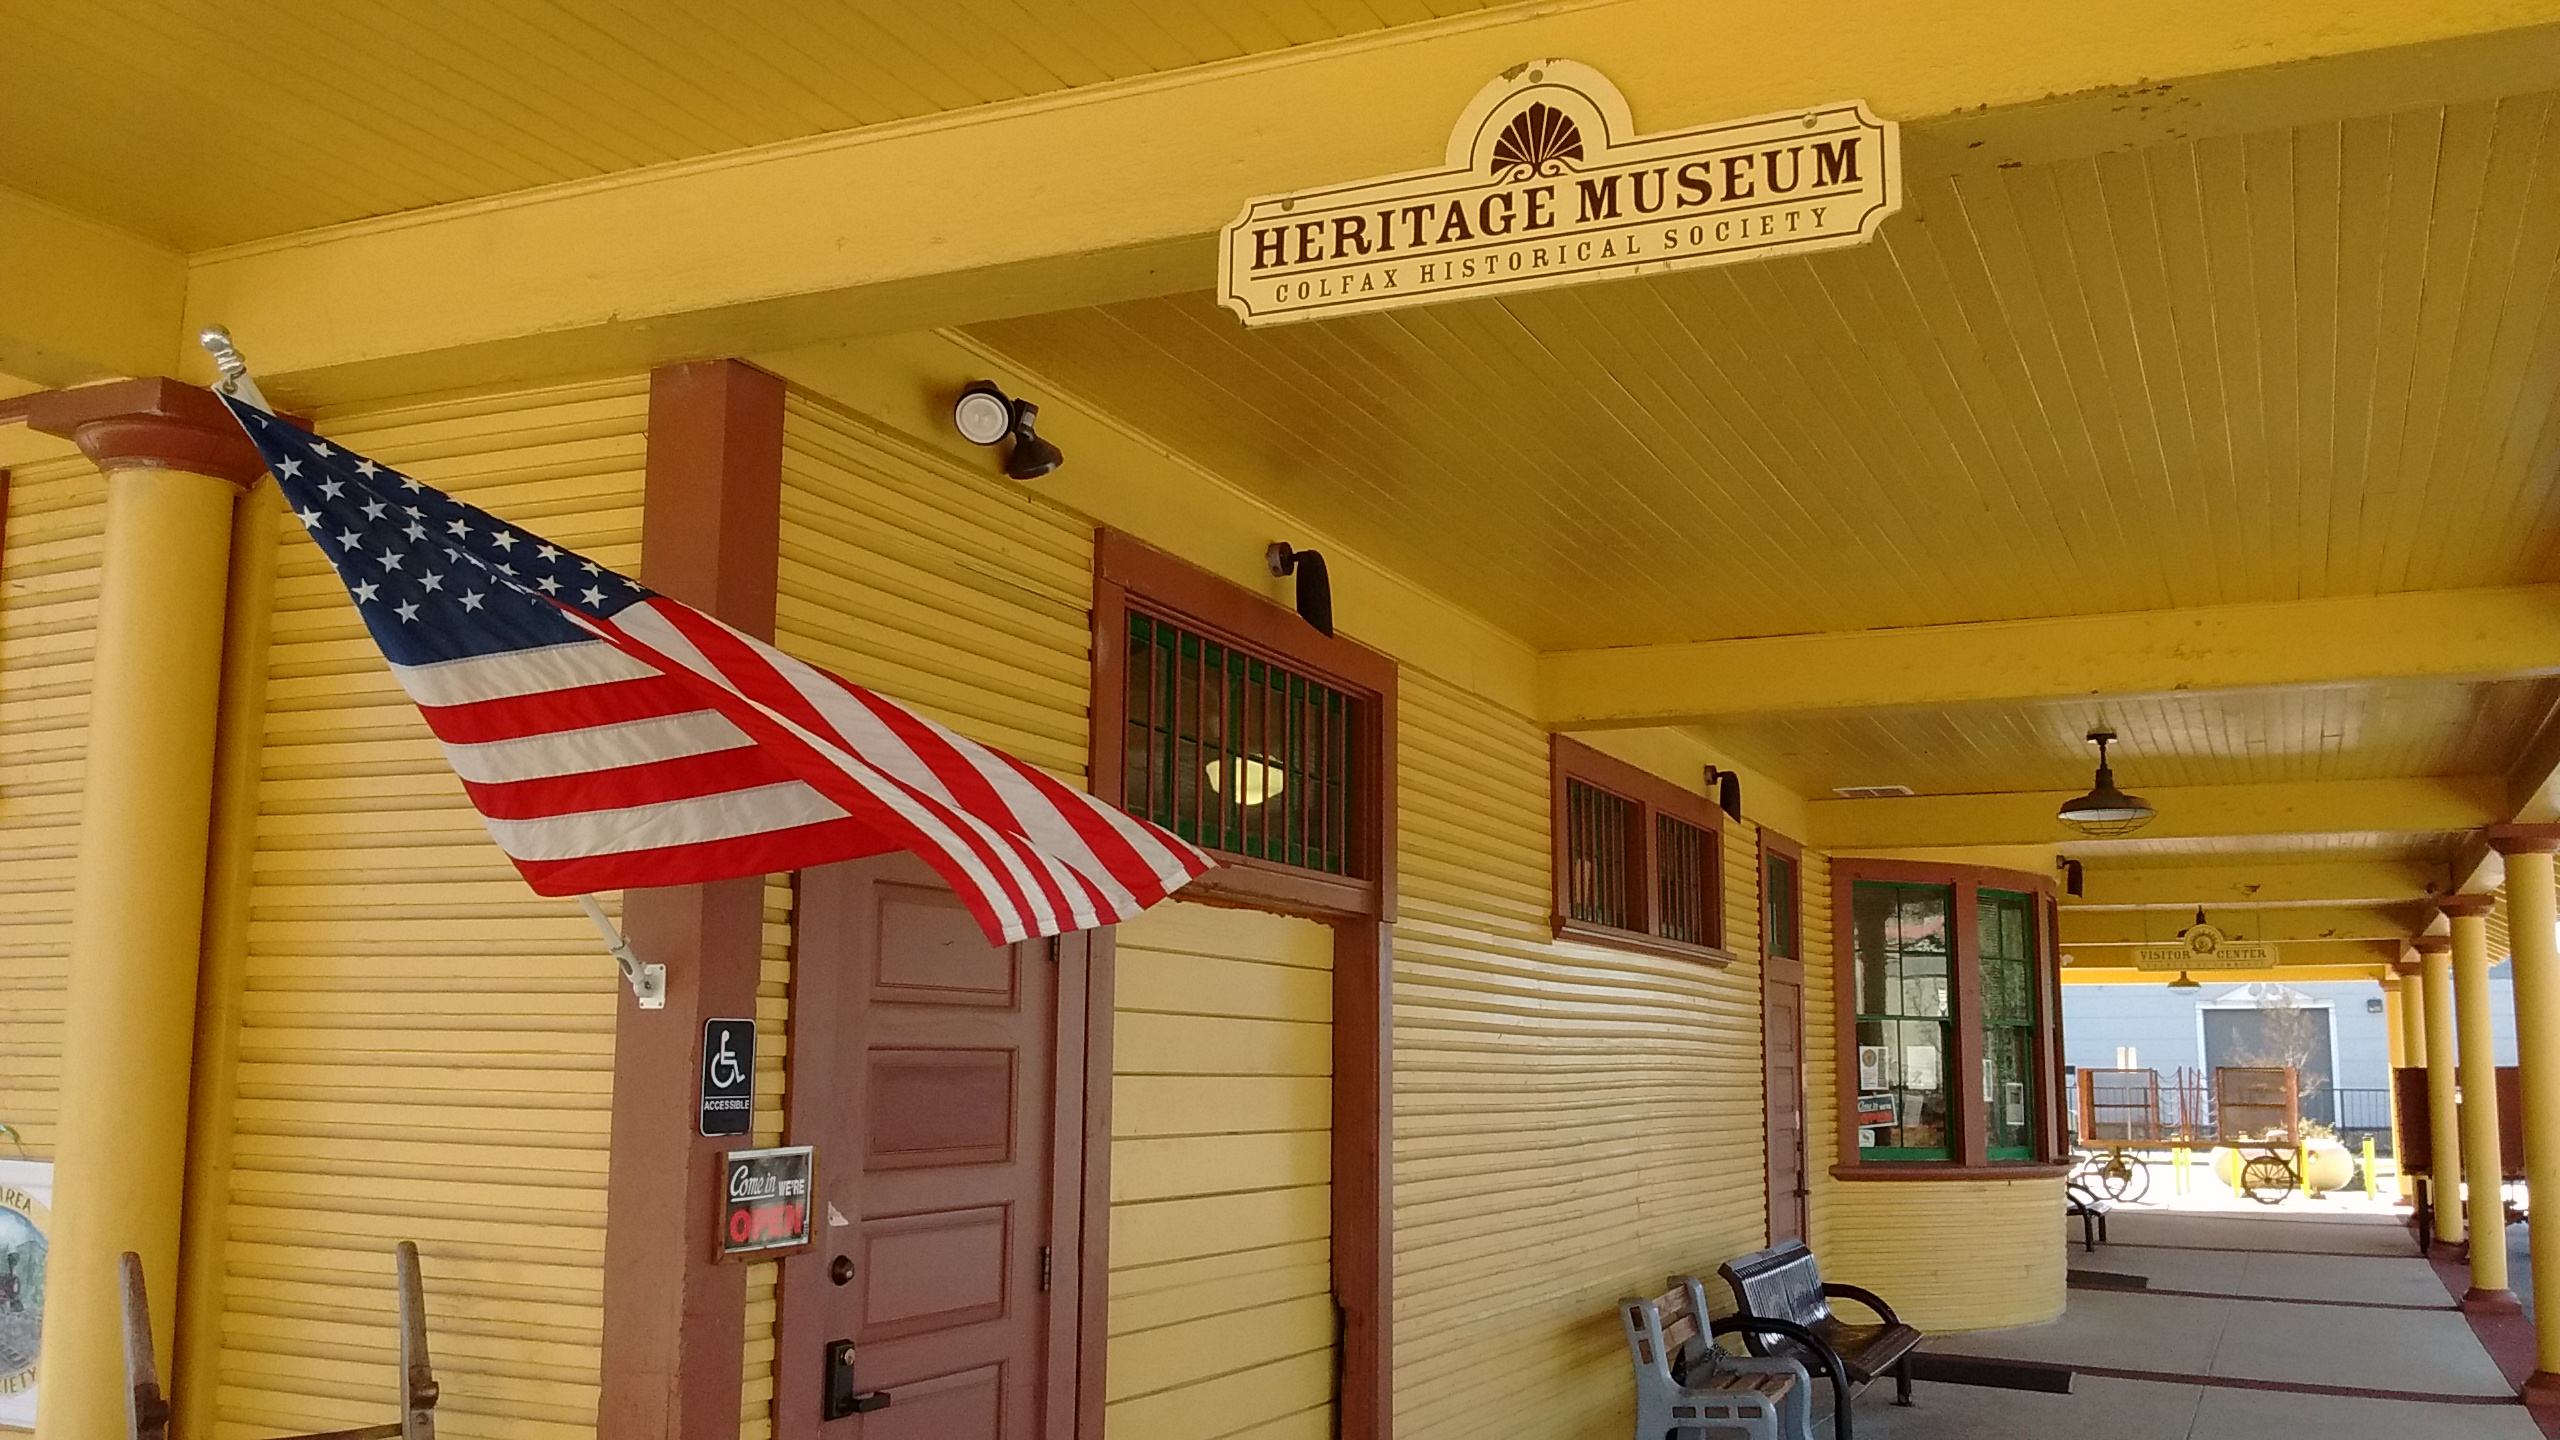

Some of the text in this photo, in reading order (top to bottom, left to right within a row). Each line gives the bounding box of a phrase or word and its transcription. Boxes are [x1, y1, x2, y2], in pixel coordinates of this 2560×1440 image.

[1250, 137, 1863, 270] HERITAGE MUSEUM
[1275, 207, 1827, 302] COLFAX HISTORICAL SOCIETY
[2140, 949, 2267, 960] VISITOR CENTER
[704, 1100, 749, 1110] ACCESSIBLE
[730, 1165, 805, 1196] Come in WE'RE
[730, 1204, 803, 1242] OPEN
[0, 1366, 36, 1393] IETY
